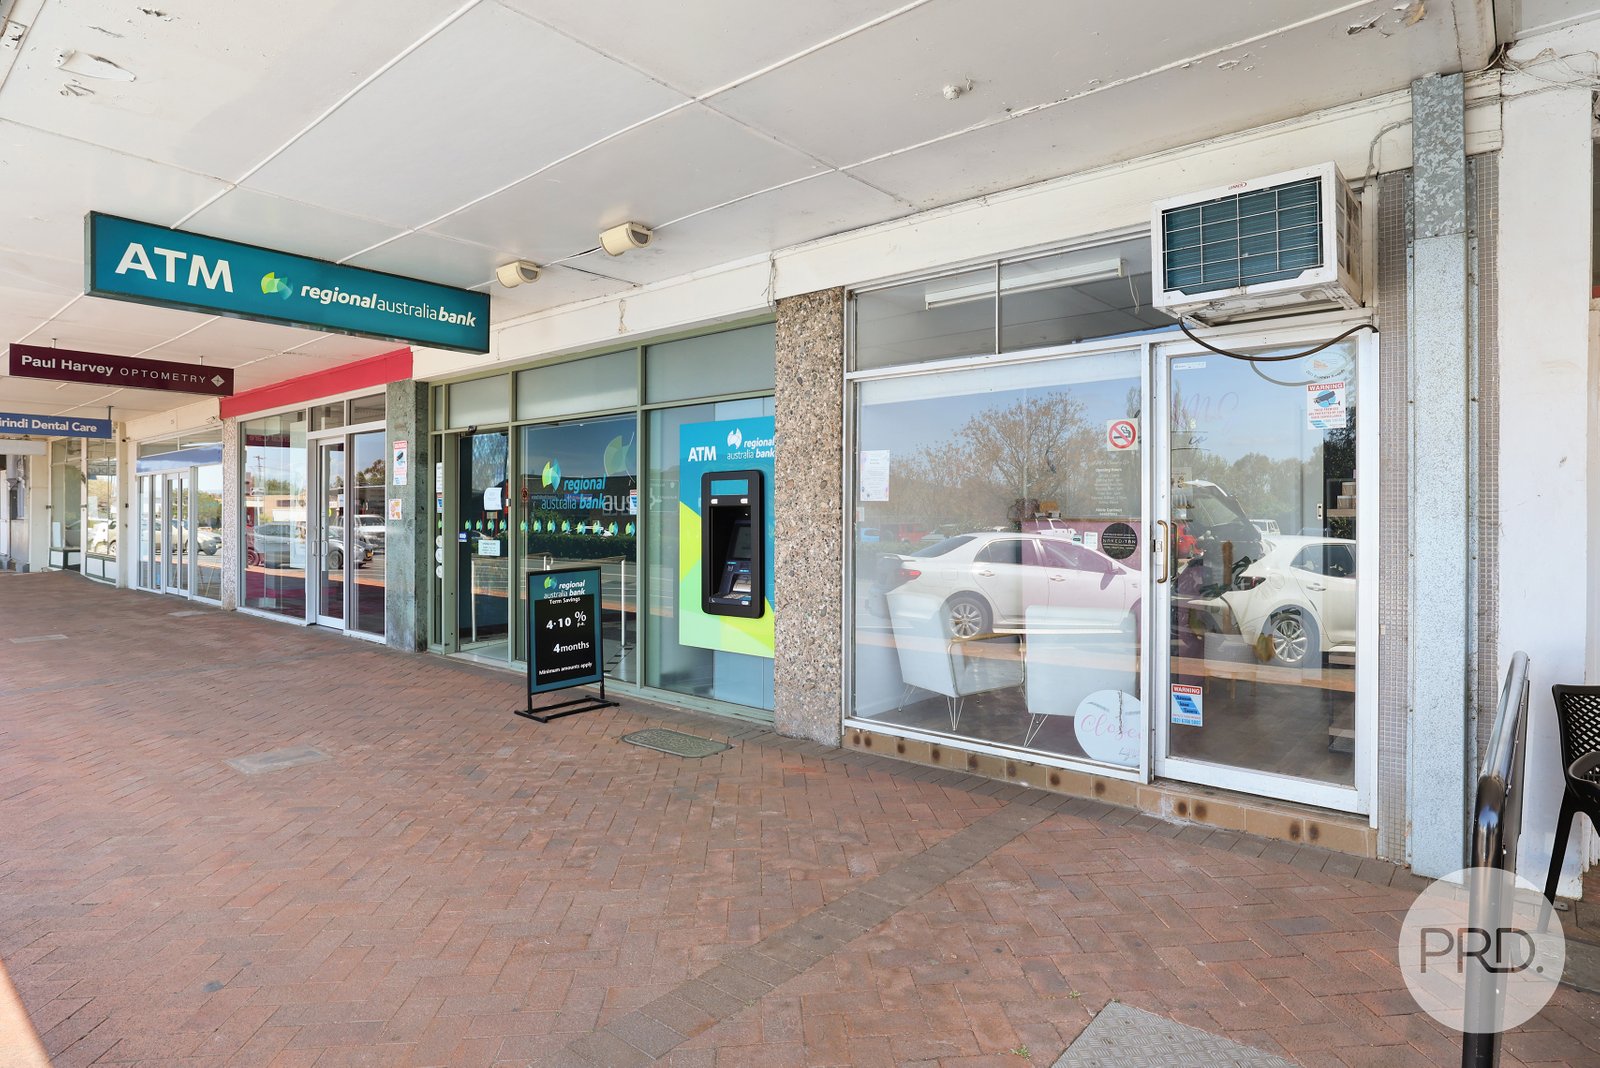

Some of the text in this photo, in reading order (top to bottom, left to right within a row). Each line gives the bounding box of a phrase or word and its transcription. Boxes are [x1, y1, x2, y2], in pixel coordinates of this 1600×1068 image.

[114, 241, 234, 294] ATM
[21, 355, 206, 384] Paul Harvey OPTOMETRY
[1309, 382, 1343, 391] WARNING
[31, 419, 69, 432] Dental
[71, 422, 97, 433] Care
[743, 436, 775, 449] regional
[687, 445, 717, 462] ATM
[727, 448, 775, 460] australia bank
[563, 473, 606, 494] regional
[541, 493, 606, 510] australia bank
[558, 579, 586, 590] regional
[543, 588, 586, 600] australia bank
[574, 610, 587, 623] %
[538, 661, 593, 676] Minimum amounts apply
